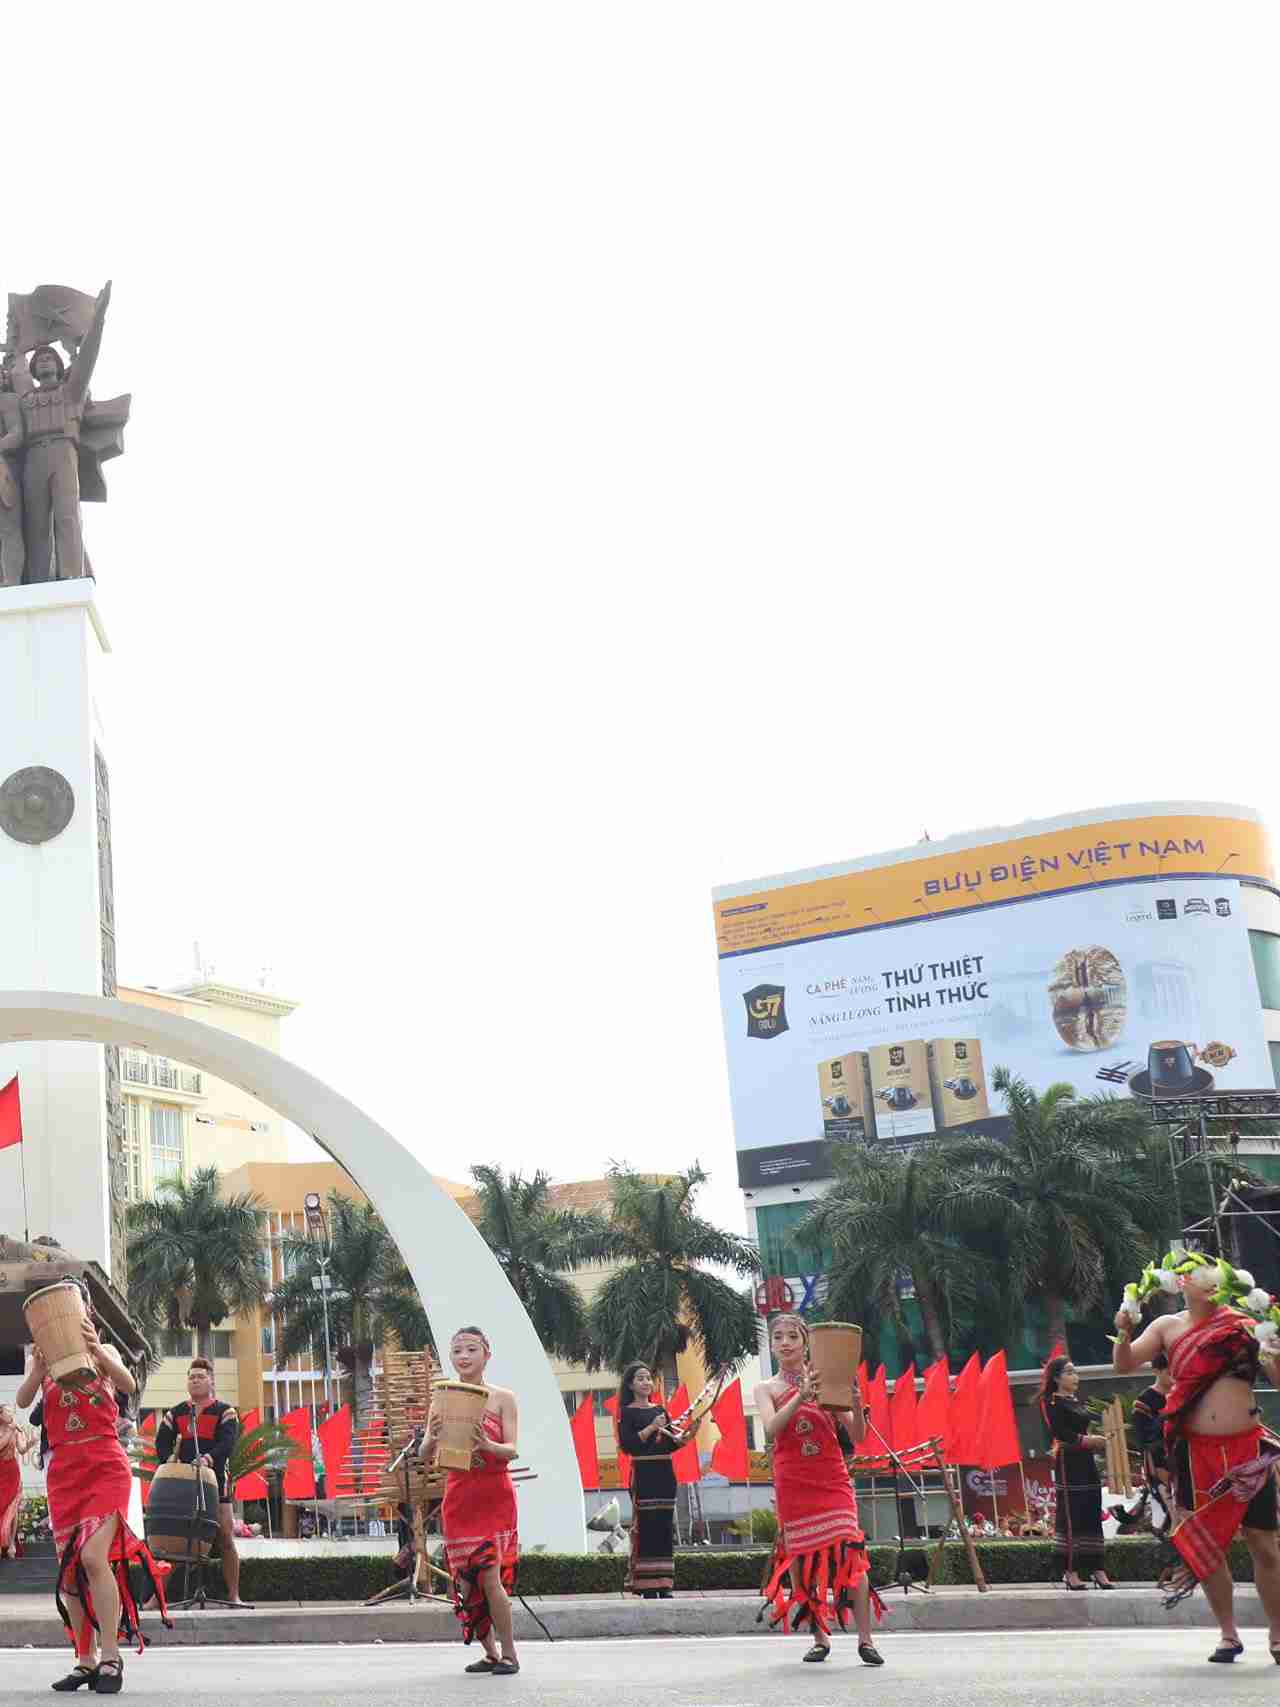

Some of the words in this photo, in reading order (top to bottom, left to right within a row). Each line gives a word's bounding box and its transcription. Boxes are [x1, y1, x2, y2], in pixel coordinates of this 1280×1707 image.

[989, 855, 1060, 882] ĐIỆN
[1067, 841, 1132, 867] VIỆT
[1138, 839, 1206, 857] NAM
[928, 953, 984, 981] THIỆT
